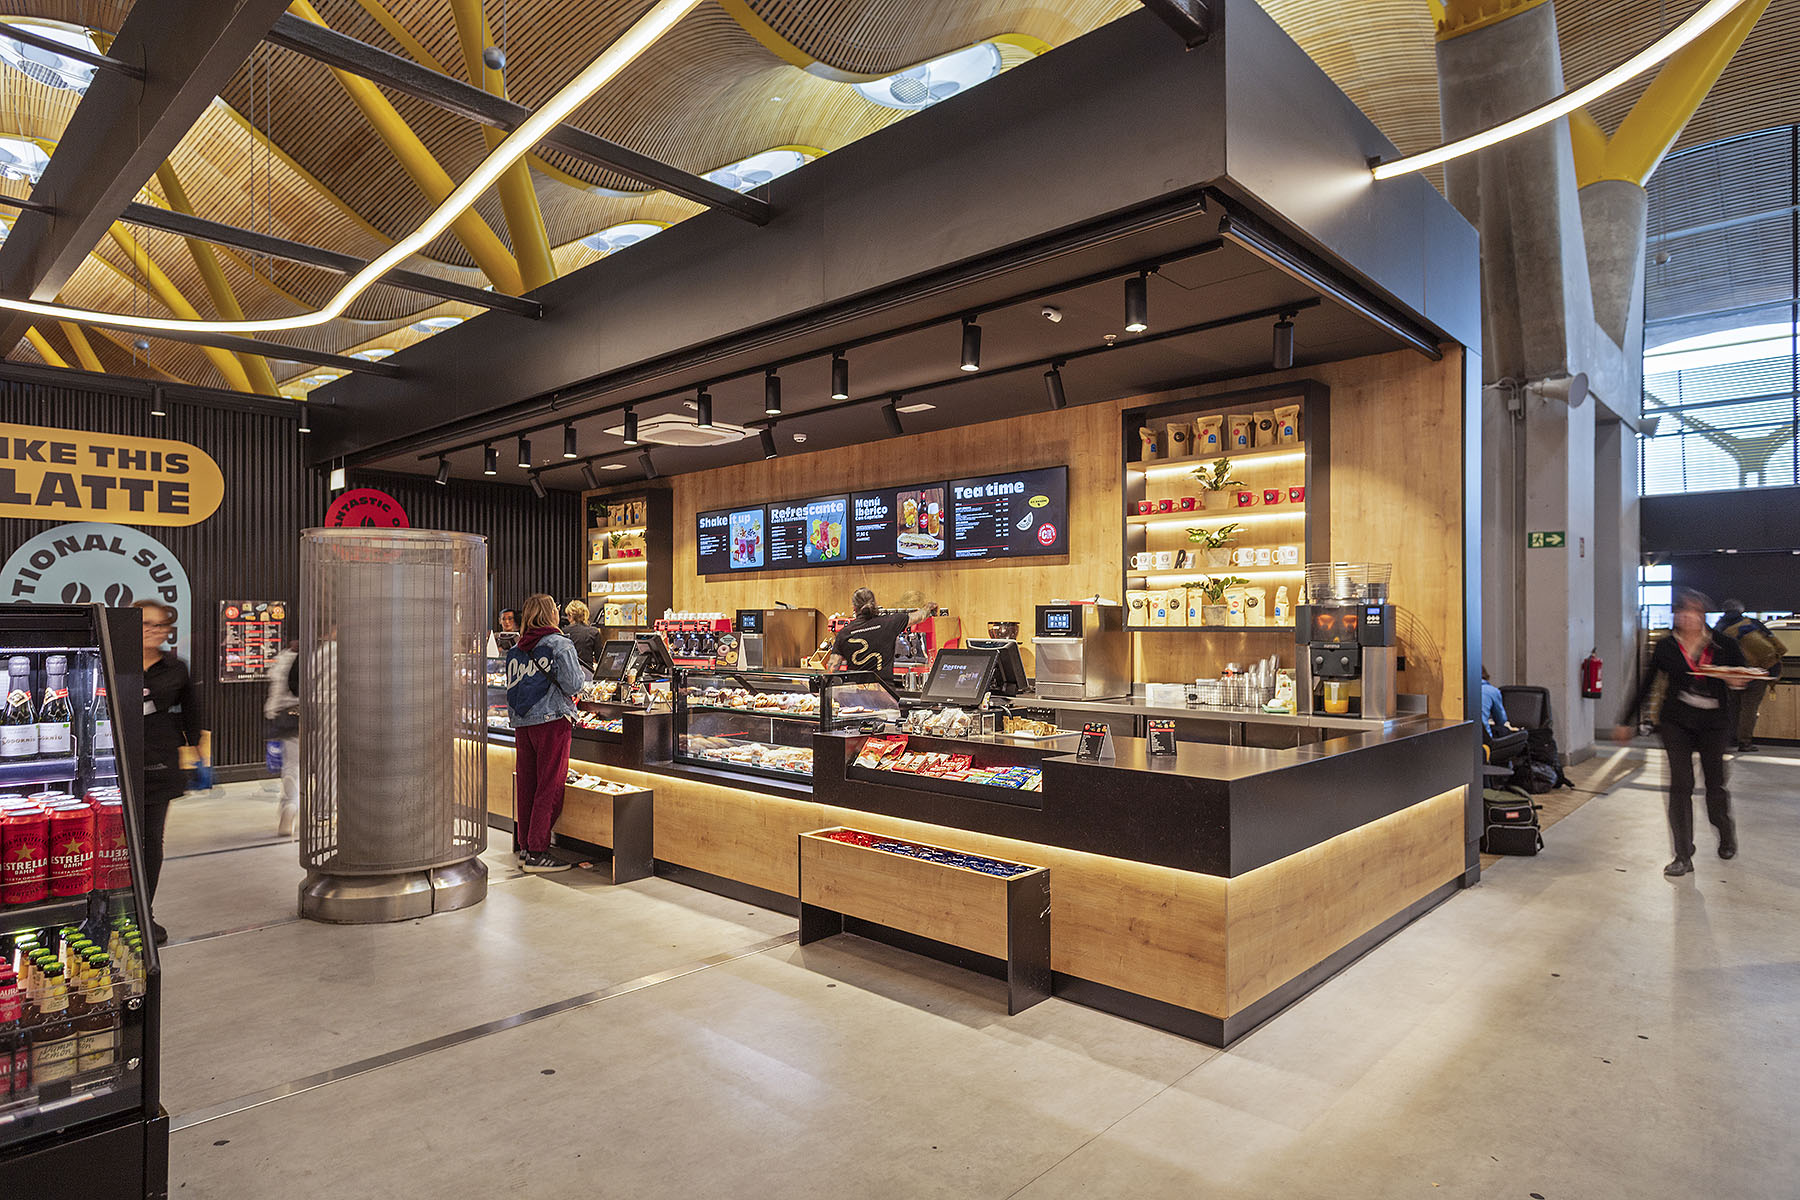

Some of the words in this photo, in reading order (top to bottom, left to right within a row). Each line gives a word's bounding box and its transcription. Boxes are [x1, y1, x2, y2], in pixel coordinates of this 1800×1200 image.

[89, 445, 190, 475] THIS
[0, 467, 190, 515] LATTE
[954, 486, 984, 500] Tea
[985, 481, 1025, 496] time
[855, 496, 881, 508] Menú
[771, 502, 844, 519] Refrescante
[699, 516, 728, 529] Shake
[738, 514, 751, 525] up
[3, 857, 47, 871] ESTRELLA
[50, 851, 94, 865] ESTRELLA
[14, 868, 35, 876] DAMM
